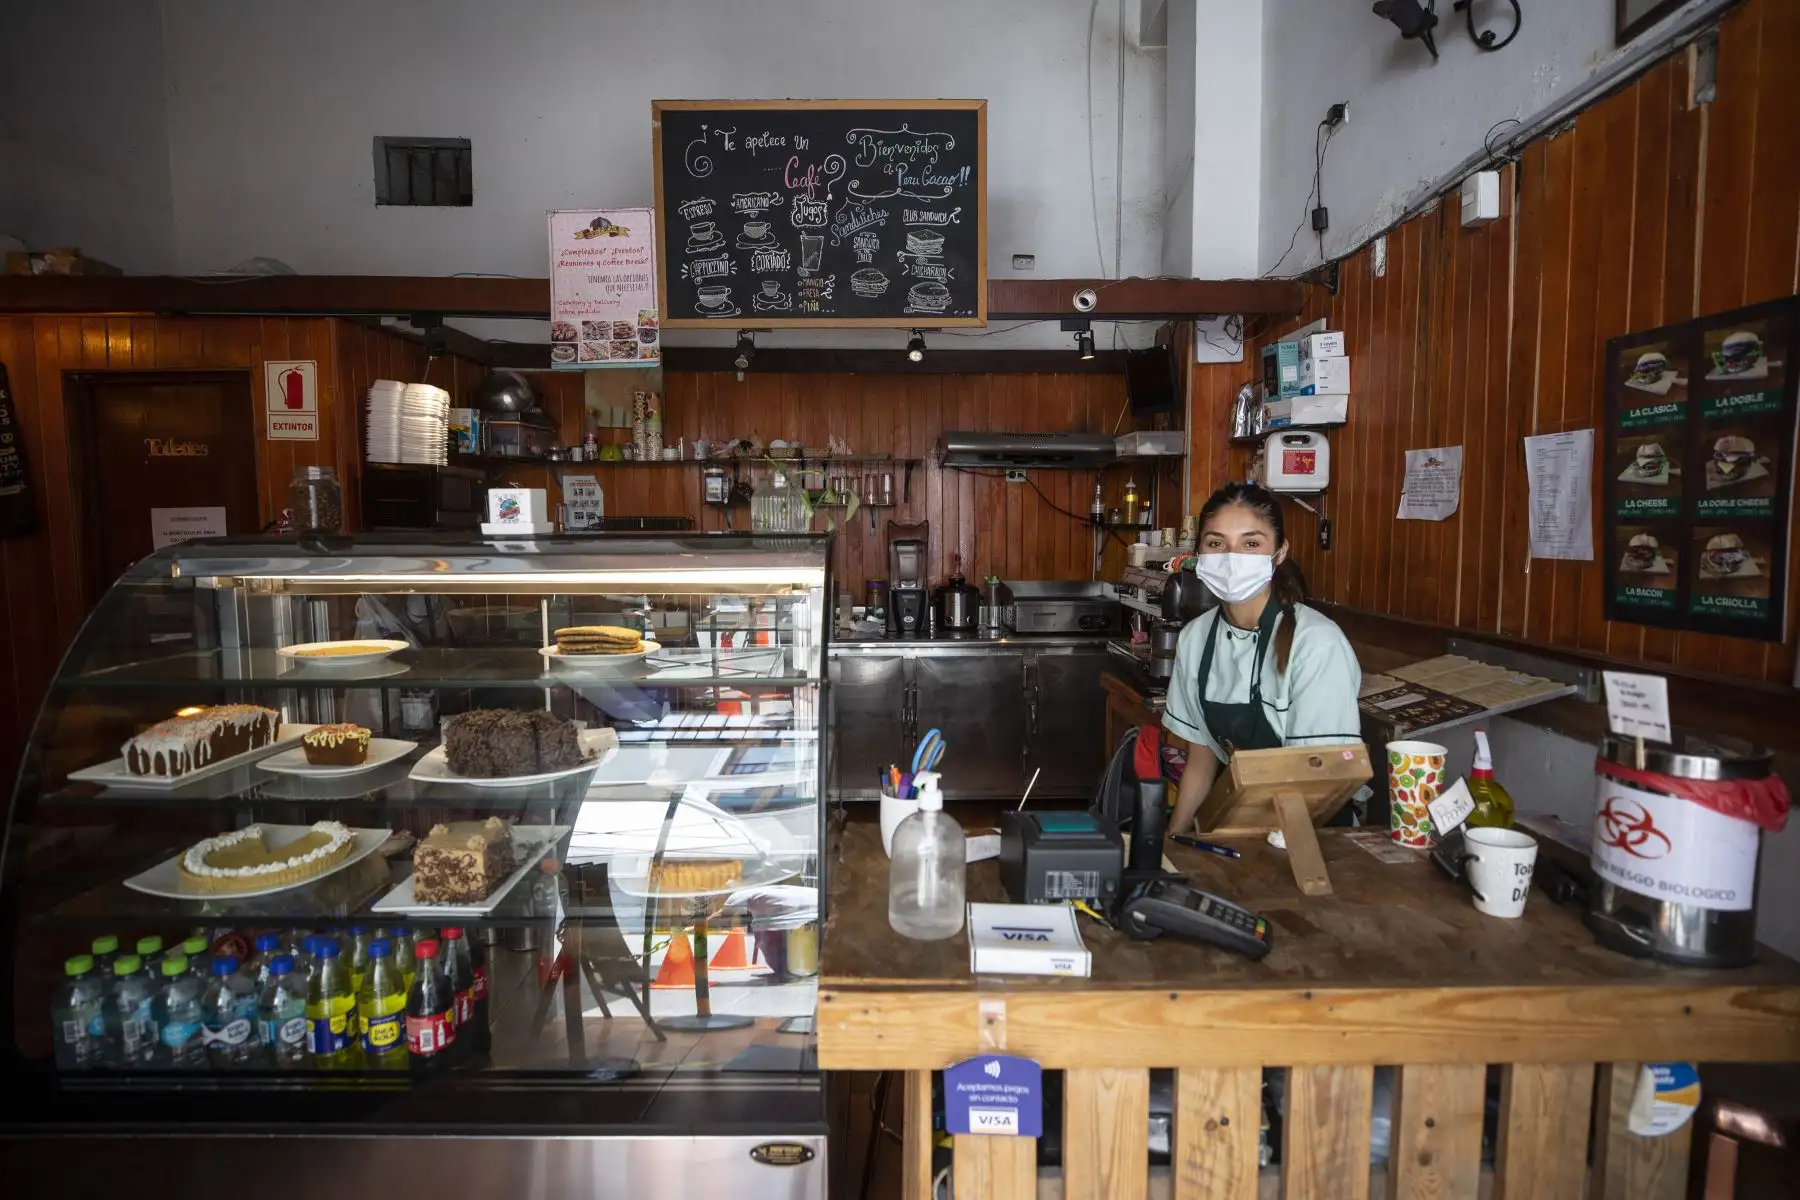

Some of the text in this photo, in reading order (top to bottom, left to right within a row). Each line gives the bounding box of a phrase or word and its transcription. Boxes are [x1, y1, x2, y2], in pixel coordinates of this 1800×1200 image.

[745, 131, 787, 157] apetece
[856, 134, 939, 168] Bienvenidos
[735, 196, 770, 210] AMERICANO
[684, 202, 713, 220] ESPRESO
[903, 208, 947, 223] CLUB SANDWICH
[755, 252, 786, 272] CORTADO
[588, 274, 612, 284] TENEMOS
[613, 274, 622, 283] LAS
[803, 288, 820, 298] FRESA
[1715, 398, 1729, 408] LA
[1730, 392, 1766, 406] DOBLE
[1630, 402, 1679, 418] LA CLASICA
[273, 422, 314, 432] EXTINTOR
[1625, 498, 1669, 508] LA CHEESE
[1697, 500, 1709, 508] LA
[1625, 587, 1664, 598] LA BACON
[1701, 595, 1758, 609] LA CRIOLLA
[1610, 863, 1655, 888] RIESGO
[1658, 879, 1737, 901] BIOLOGICO
[1002, 931, 1050, 941] VISA
[956, 1082, 1003, 1093] Aceptamos
[981, 1094, 1019, 1104] contacto
[978, 1115, 1012, 1125] VISA
